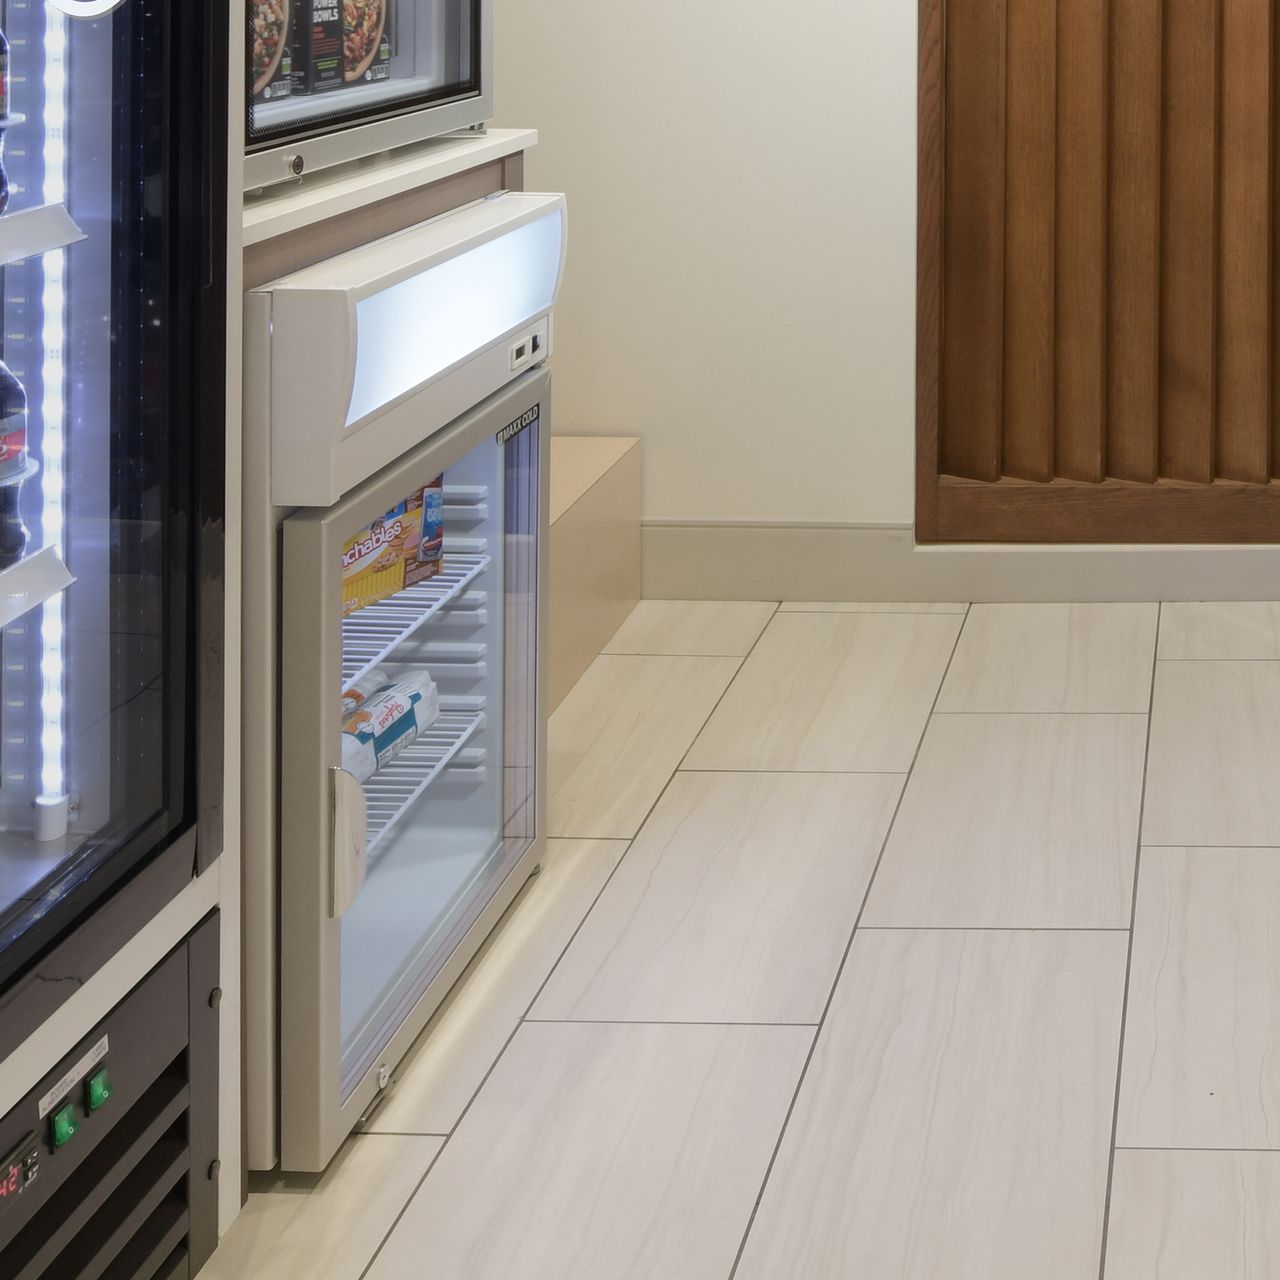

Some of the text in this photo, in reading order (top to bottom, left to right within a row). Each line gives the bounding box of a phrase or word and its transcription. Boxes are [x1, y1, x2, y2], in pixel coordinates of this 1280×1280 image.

[312, 9, 339, 23] BOWLS
[503, 406, 538, 441] MAXX COLD
